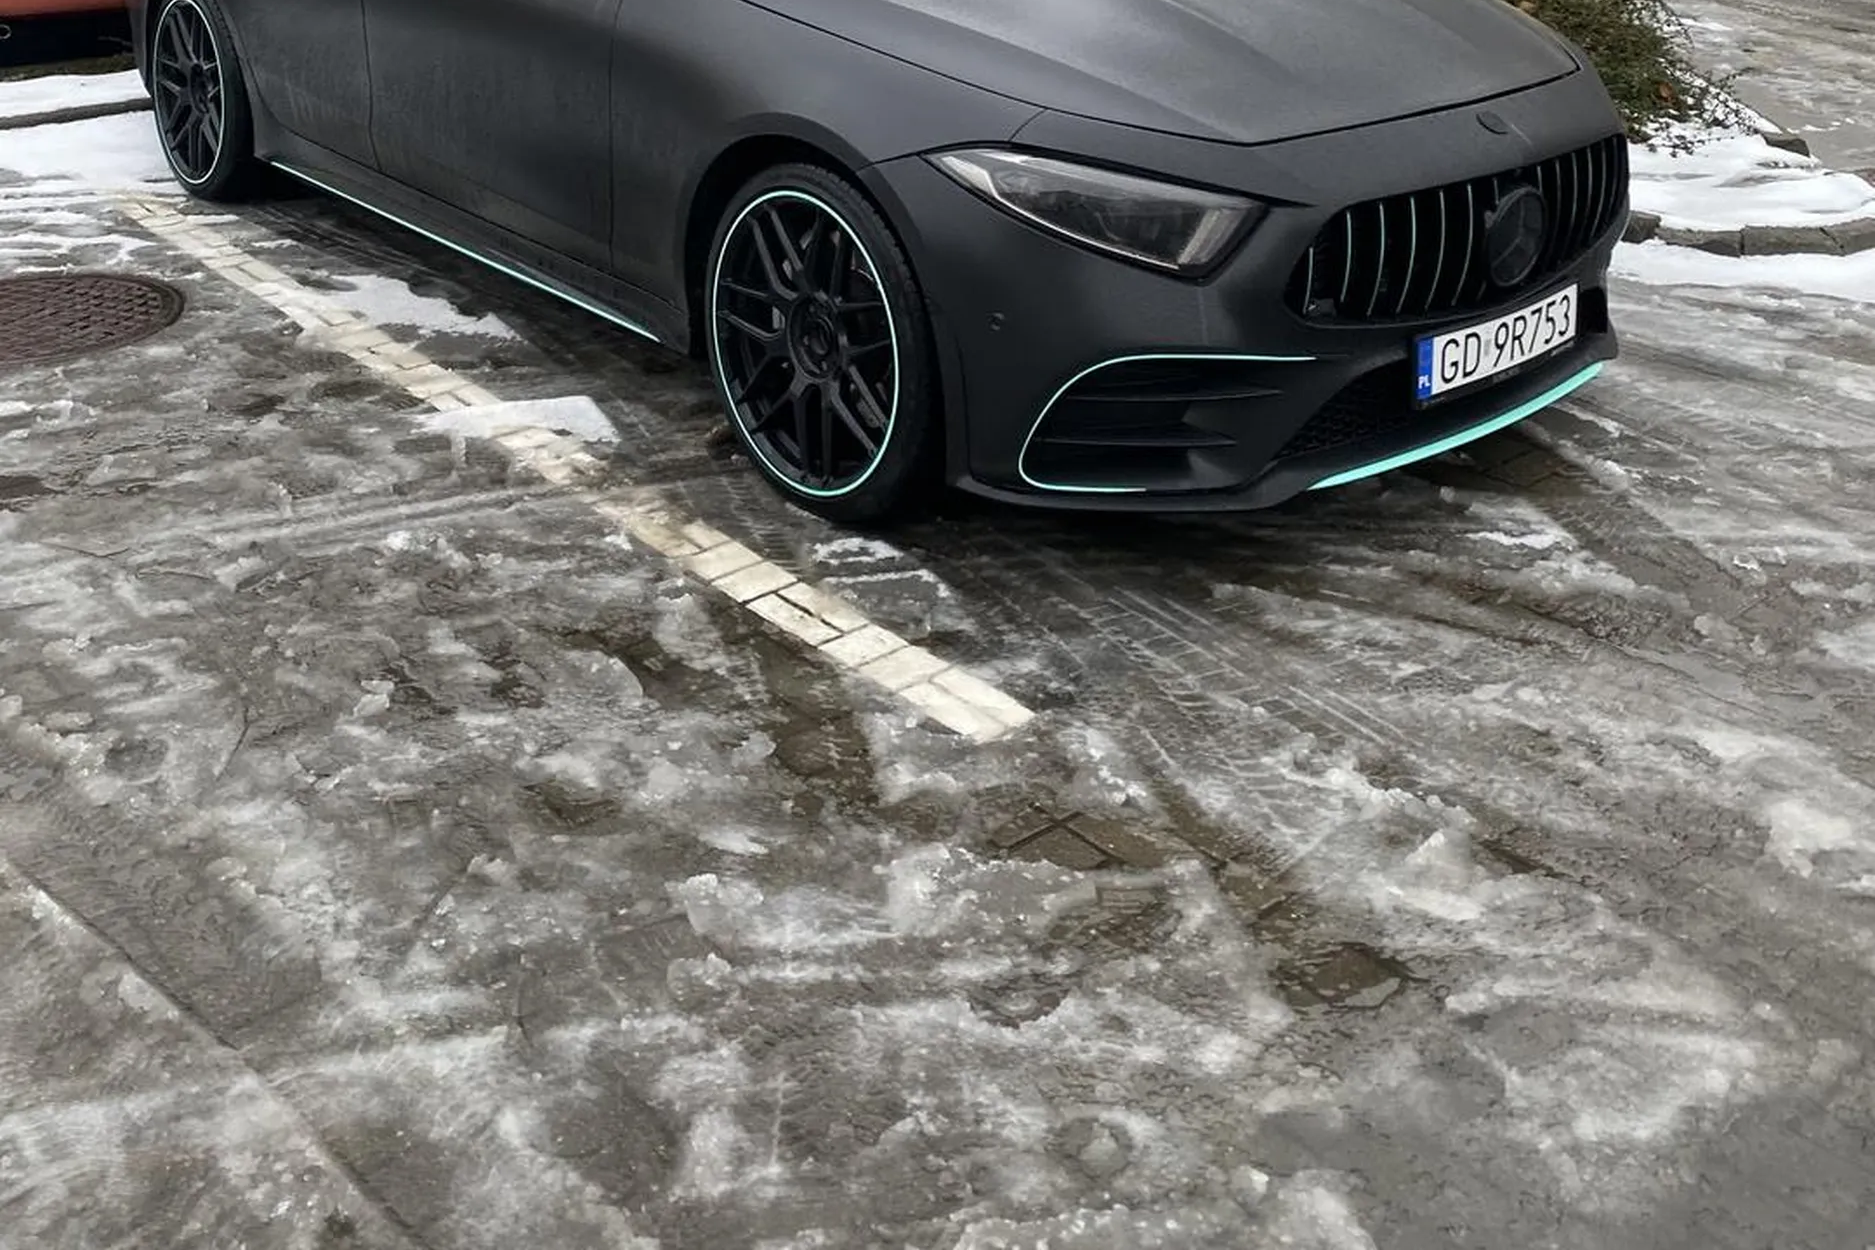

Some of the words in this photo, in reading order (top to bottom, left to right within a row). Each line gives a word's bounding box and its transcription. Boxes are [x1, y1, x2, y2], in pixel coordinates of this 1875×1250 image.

[1440, 331, 1482, 384] GD
[1493, 294, 1571, 368] 9R753
[1417, 374, 1431, 390] PL
